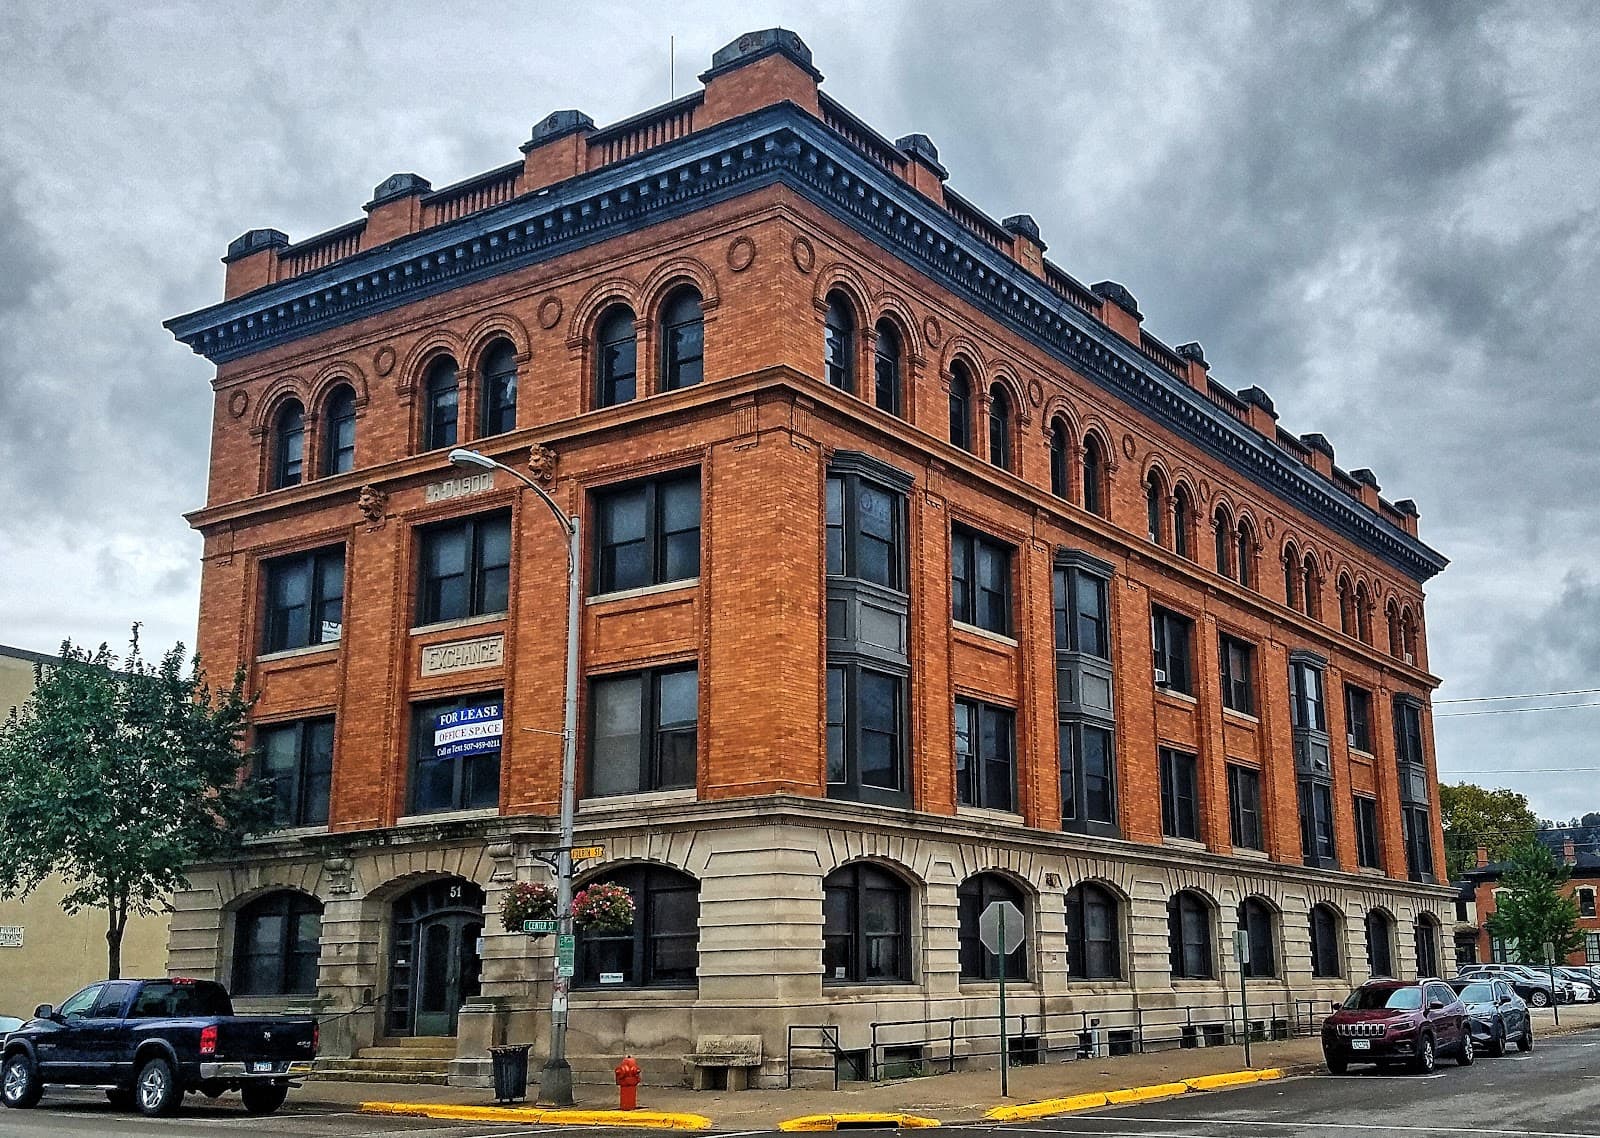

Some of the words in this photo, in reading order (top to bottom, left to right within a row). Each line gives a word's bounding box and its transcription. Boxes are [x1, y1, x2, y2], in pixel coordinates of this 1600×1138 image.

[440, 711, 458, 726] FOR
[460, 705, 499, 721] LEASE
[440, 727, 467, 742] OFFICE
[468, 723, 501, 736] SPACE
[452, 744, 463, 753] Text
[450, 885, 462, 898] 51
[528, 921, 547, 930] CENTER
[548, 921, 555, 930] ST
